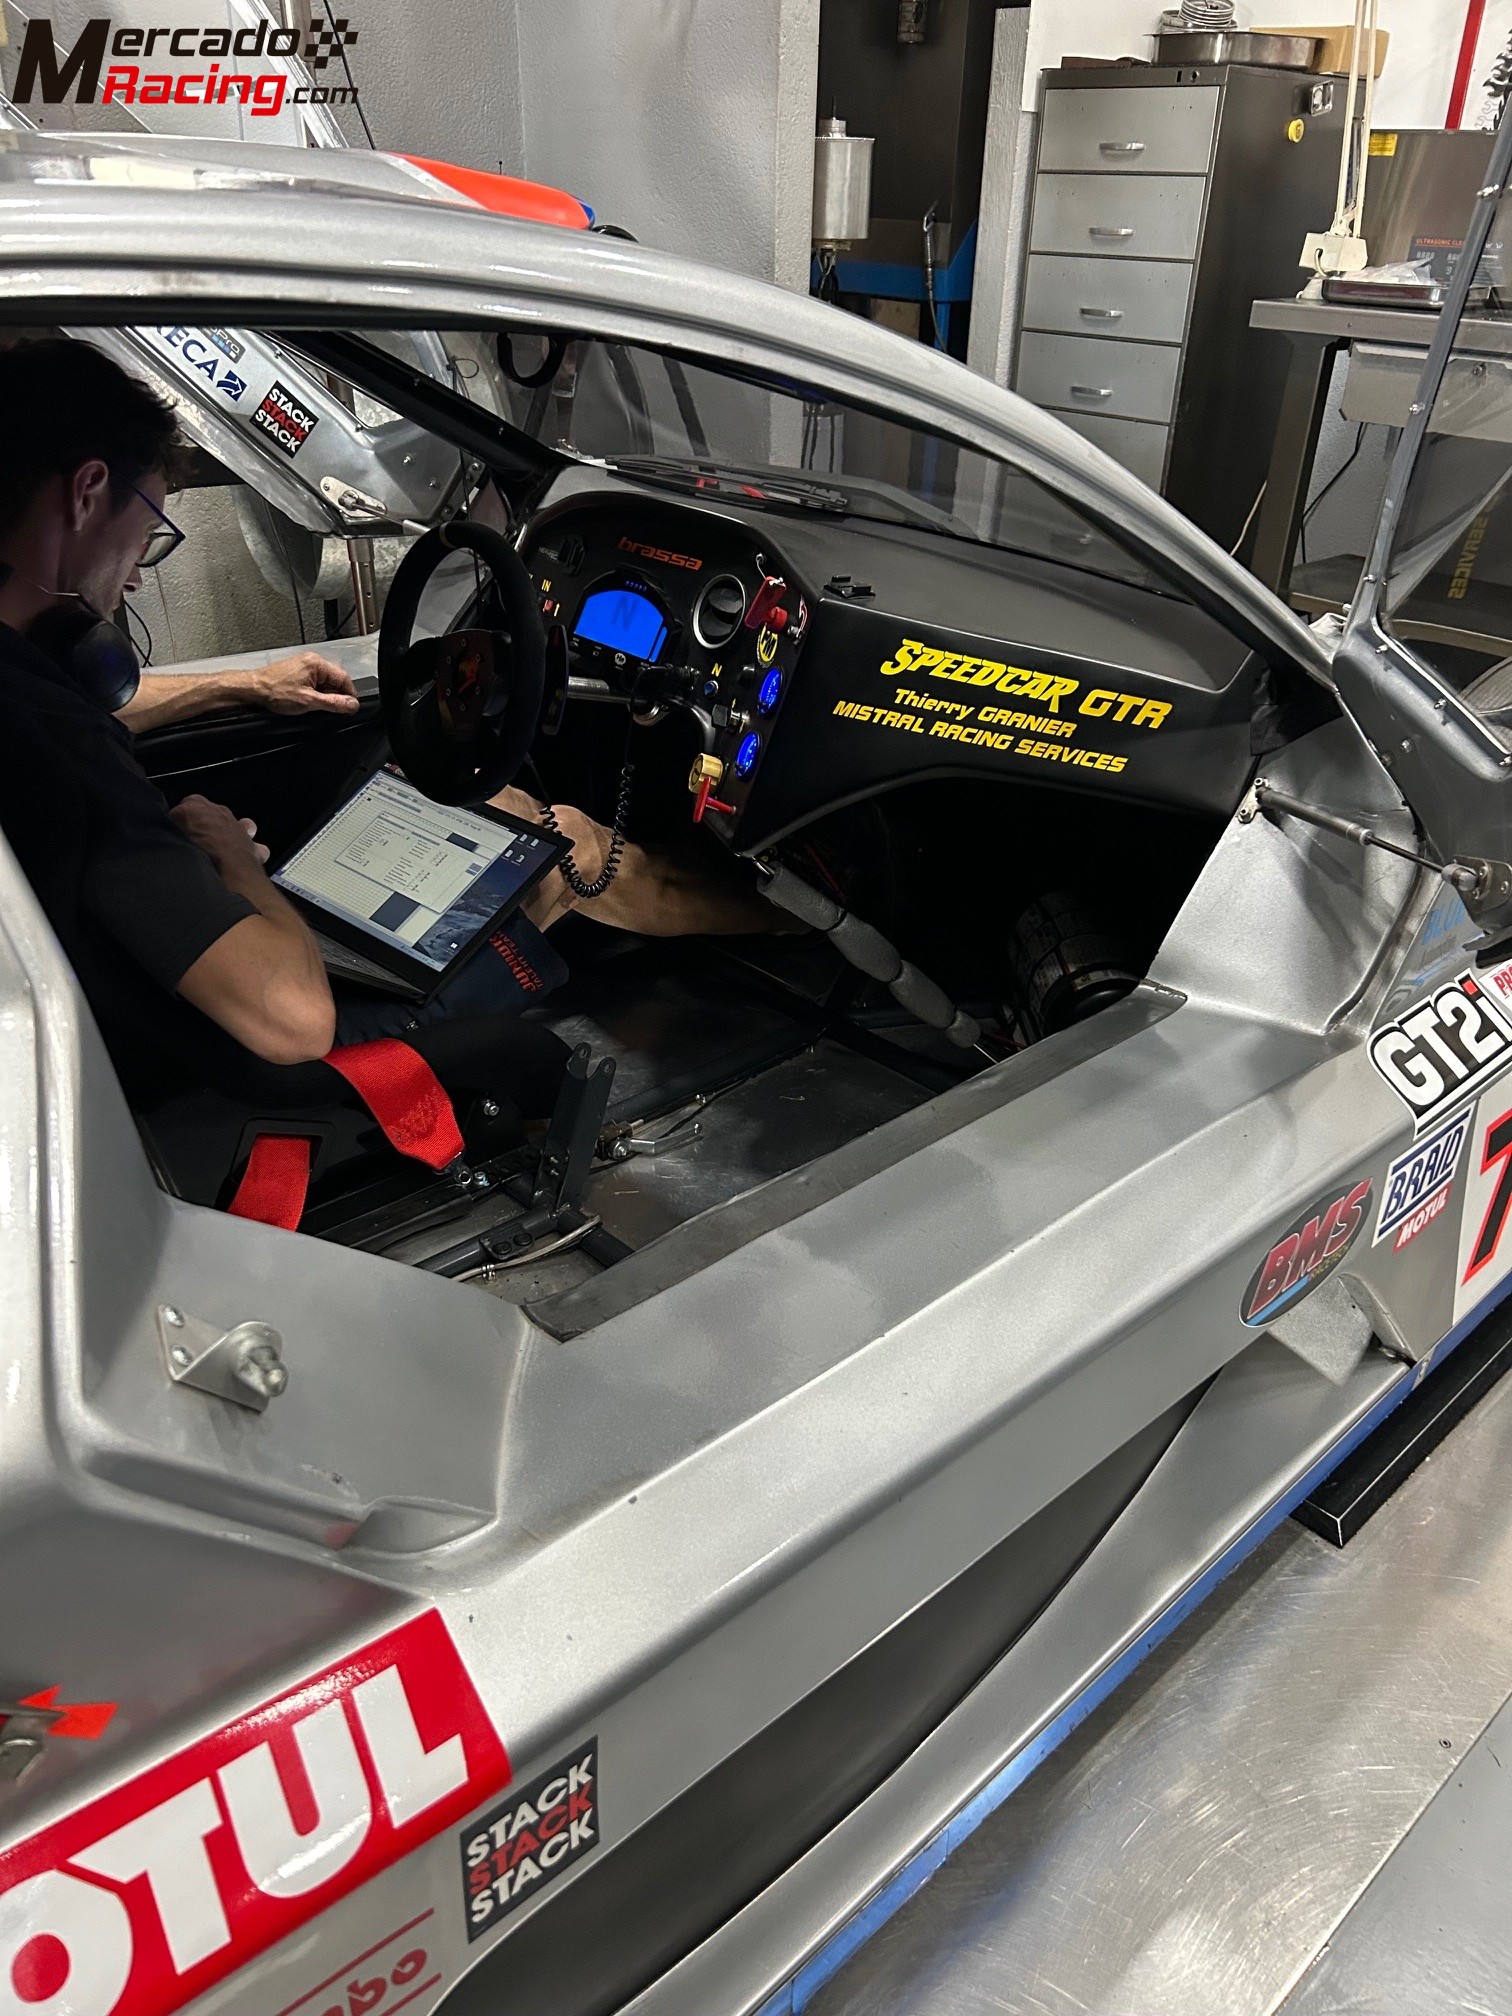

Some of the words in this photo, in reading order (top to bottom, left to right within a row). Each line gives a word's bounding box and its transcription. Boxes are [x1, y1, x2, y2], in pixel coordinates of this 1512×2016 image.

[1416, 238, 1450, 246] ULTRASONIC
[255, 410, 302, 453] STACK
[261, 400, 308, 442] STACK
[268, 389, 315, 432] STACK
[618, 536, 703, 571] brassa
[541, 579, 552, 593] IN
[711, 662, 723, 677] N
[880, 639, 1079, 714] SPEEDCAR
[1079, 689, 1173, 729] GTR
[832, 701, 924, 734] MISTRAL
[929, 721, 1014, 750] RACING
[1014, 739, 1128, 773] SERVICES
[895, 688, 975, 721] Thierry
[977, 706, 1078, 738] GRANIER
[489, 934, 538, 992] JUNIOR
[518, 956, 544, 990] TALENT
[1492, 961, 1512, 996] PR
[1373, 979, 1512, 1106] GT2i
[1380, 1125, 1464, 1225] BRAID
[1397, 1188, 1448, 1248] MOTUL
[1247, 1178, 1373, 1319] BMS
[467, 1753, 593, 1867] STACK
[470, 1781, 594, 1896] STACK
[0, 1664, 469, 2016] OTUL
[471, 1807, 596, 1923] STACK
[320, 1948, 428, 2016] bo
